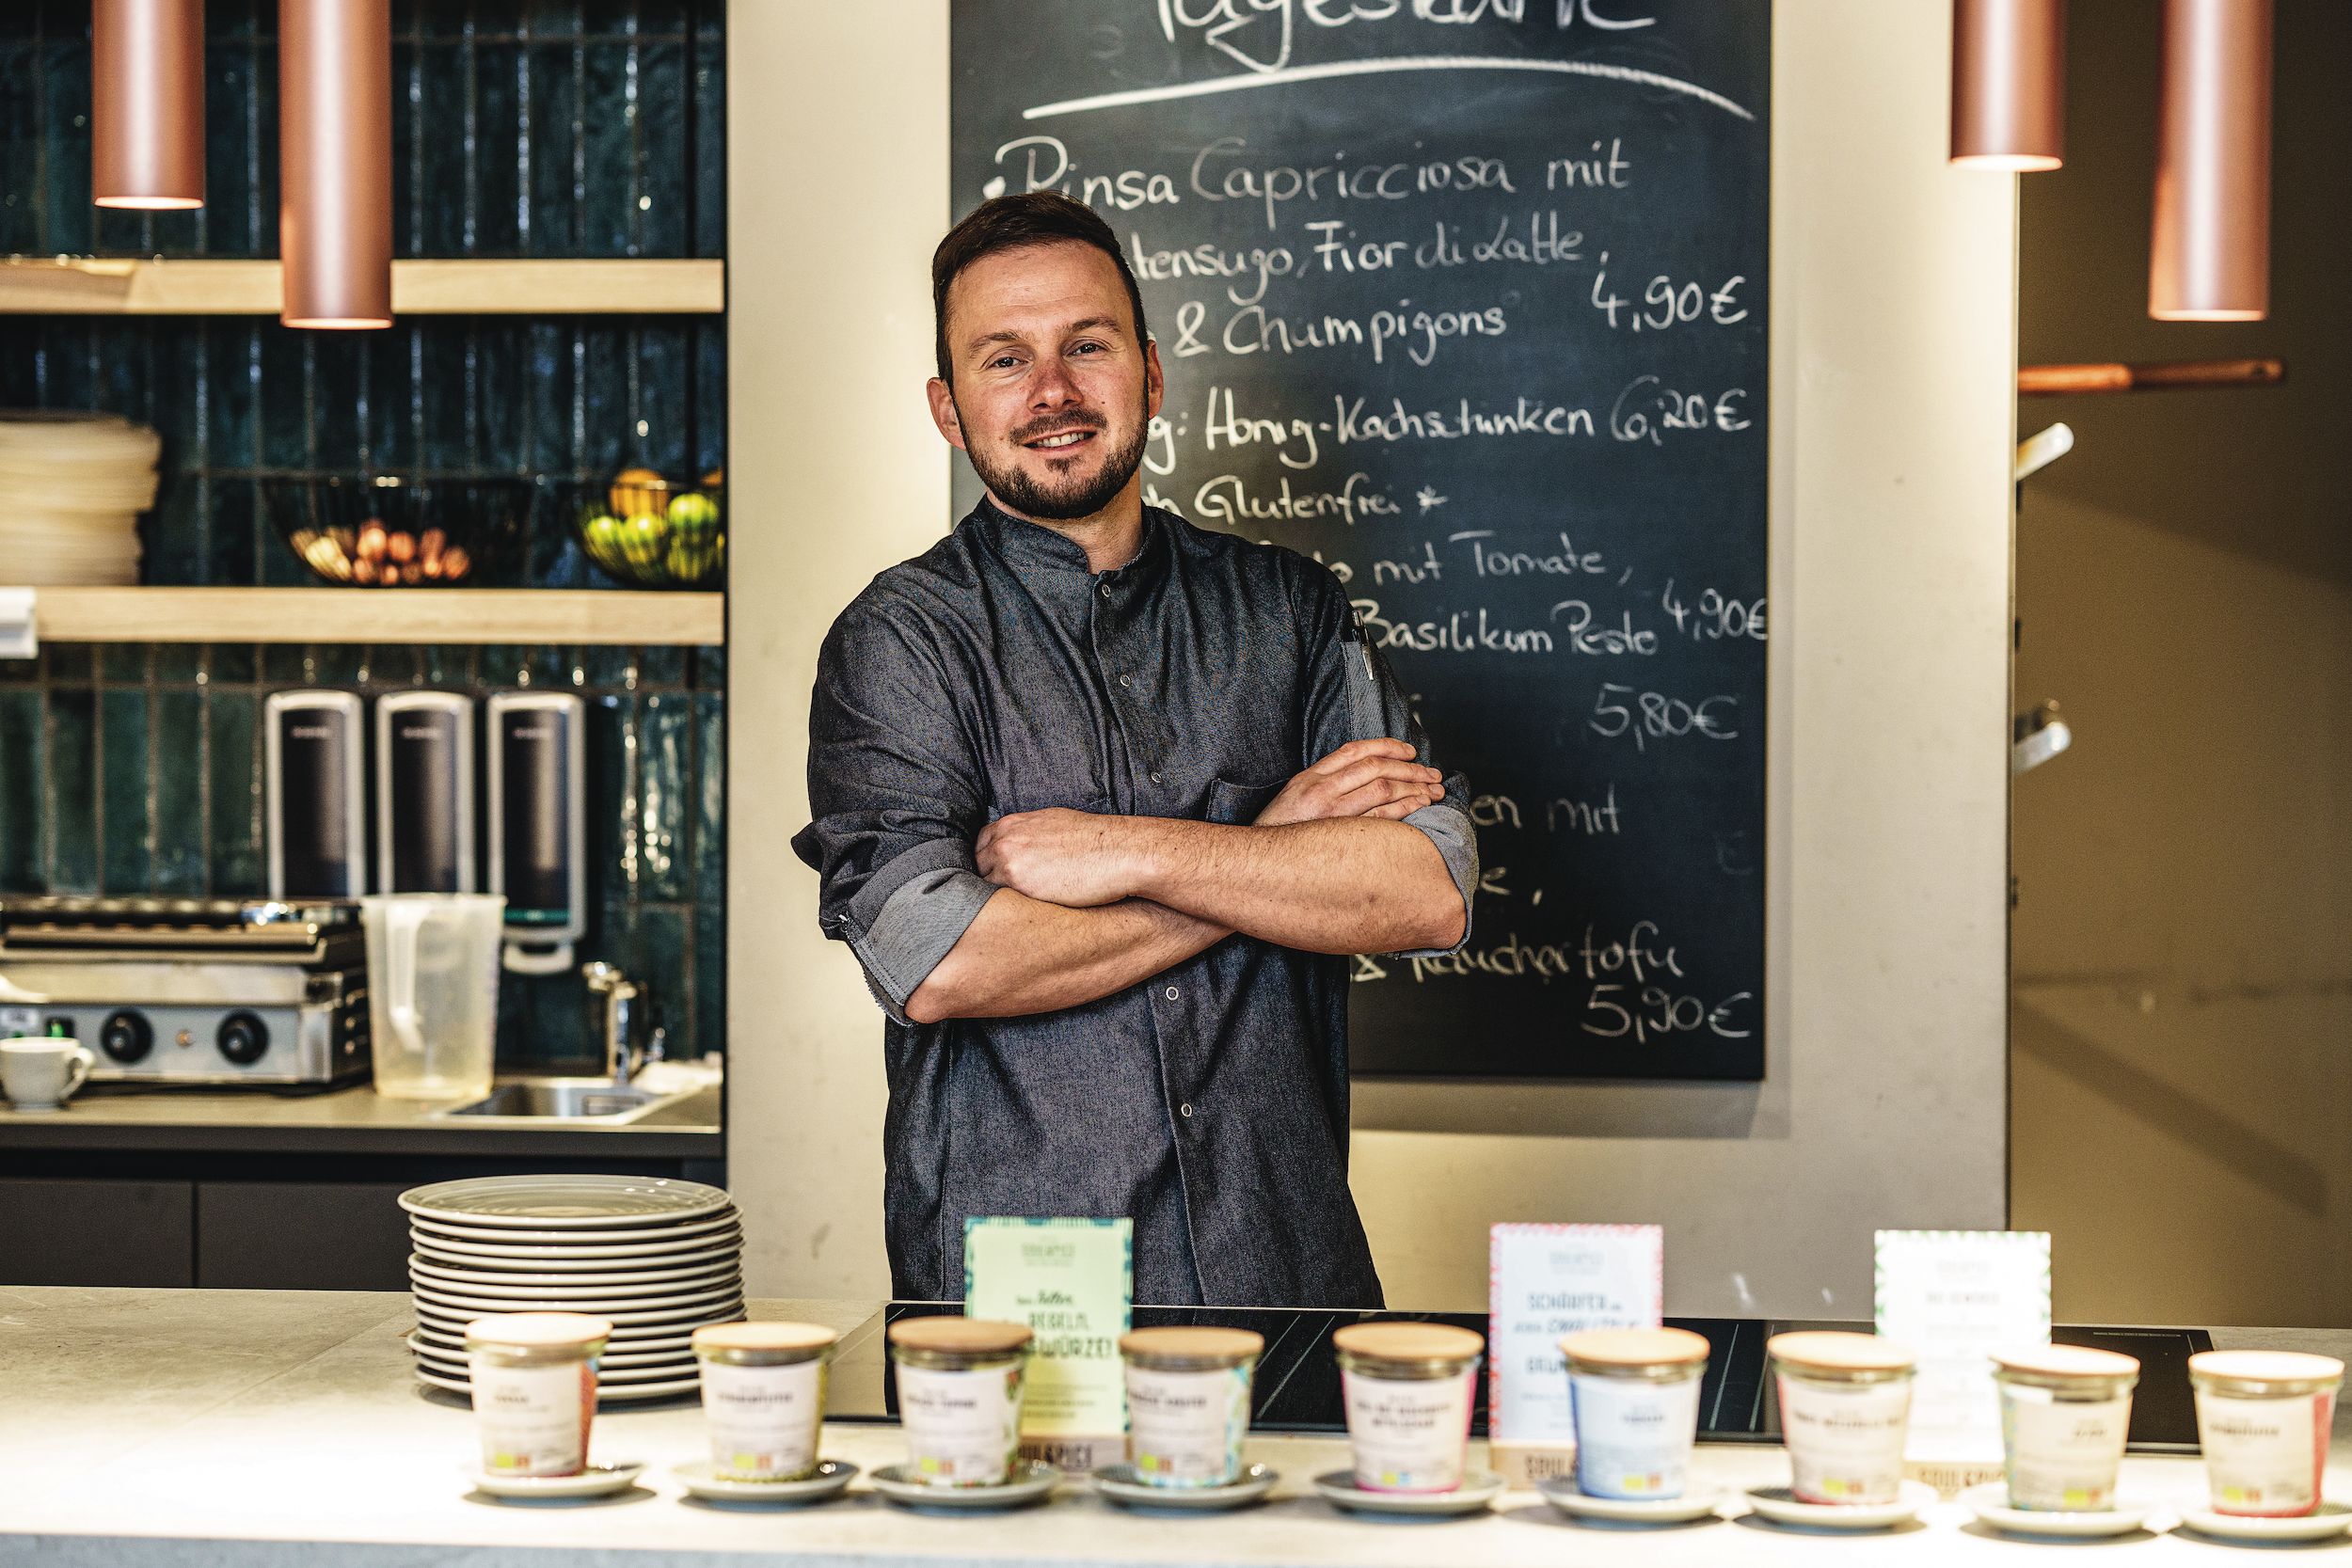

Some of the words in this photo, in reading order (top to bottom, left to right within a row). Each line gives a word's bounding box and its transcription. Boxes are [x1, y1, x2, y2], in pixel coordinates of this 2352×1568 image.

[994, 135, 1181, 211] Pinsa
[1190, 135, 1518, 231] Capricciosa
[1547, 137, 1631, 191] mit
[1304, 219, 1408, 274] Fior
[1415, 220, 1464, 269] di
[1172, 300, 1213, 358] &
[1591, 272, 1749, 333] 4,90€
[1610, 374, 1752, 446] 6,20€
[1193, 471, 1402, 526] Glutenfrei
[1373, 541, 1442, 586] mit
[1589, 682, 1740, 752] 5,80€
[1548, 781, 1621, 836] mit
[1581, 984, 1754, 1044] 5,90€
